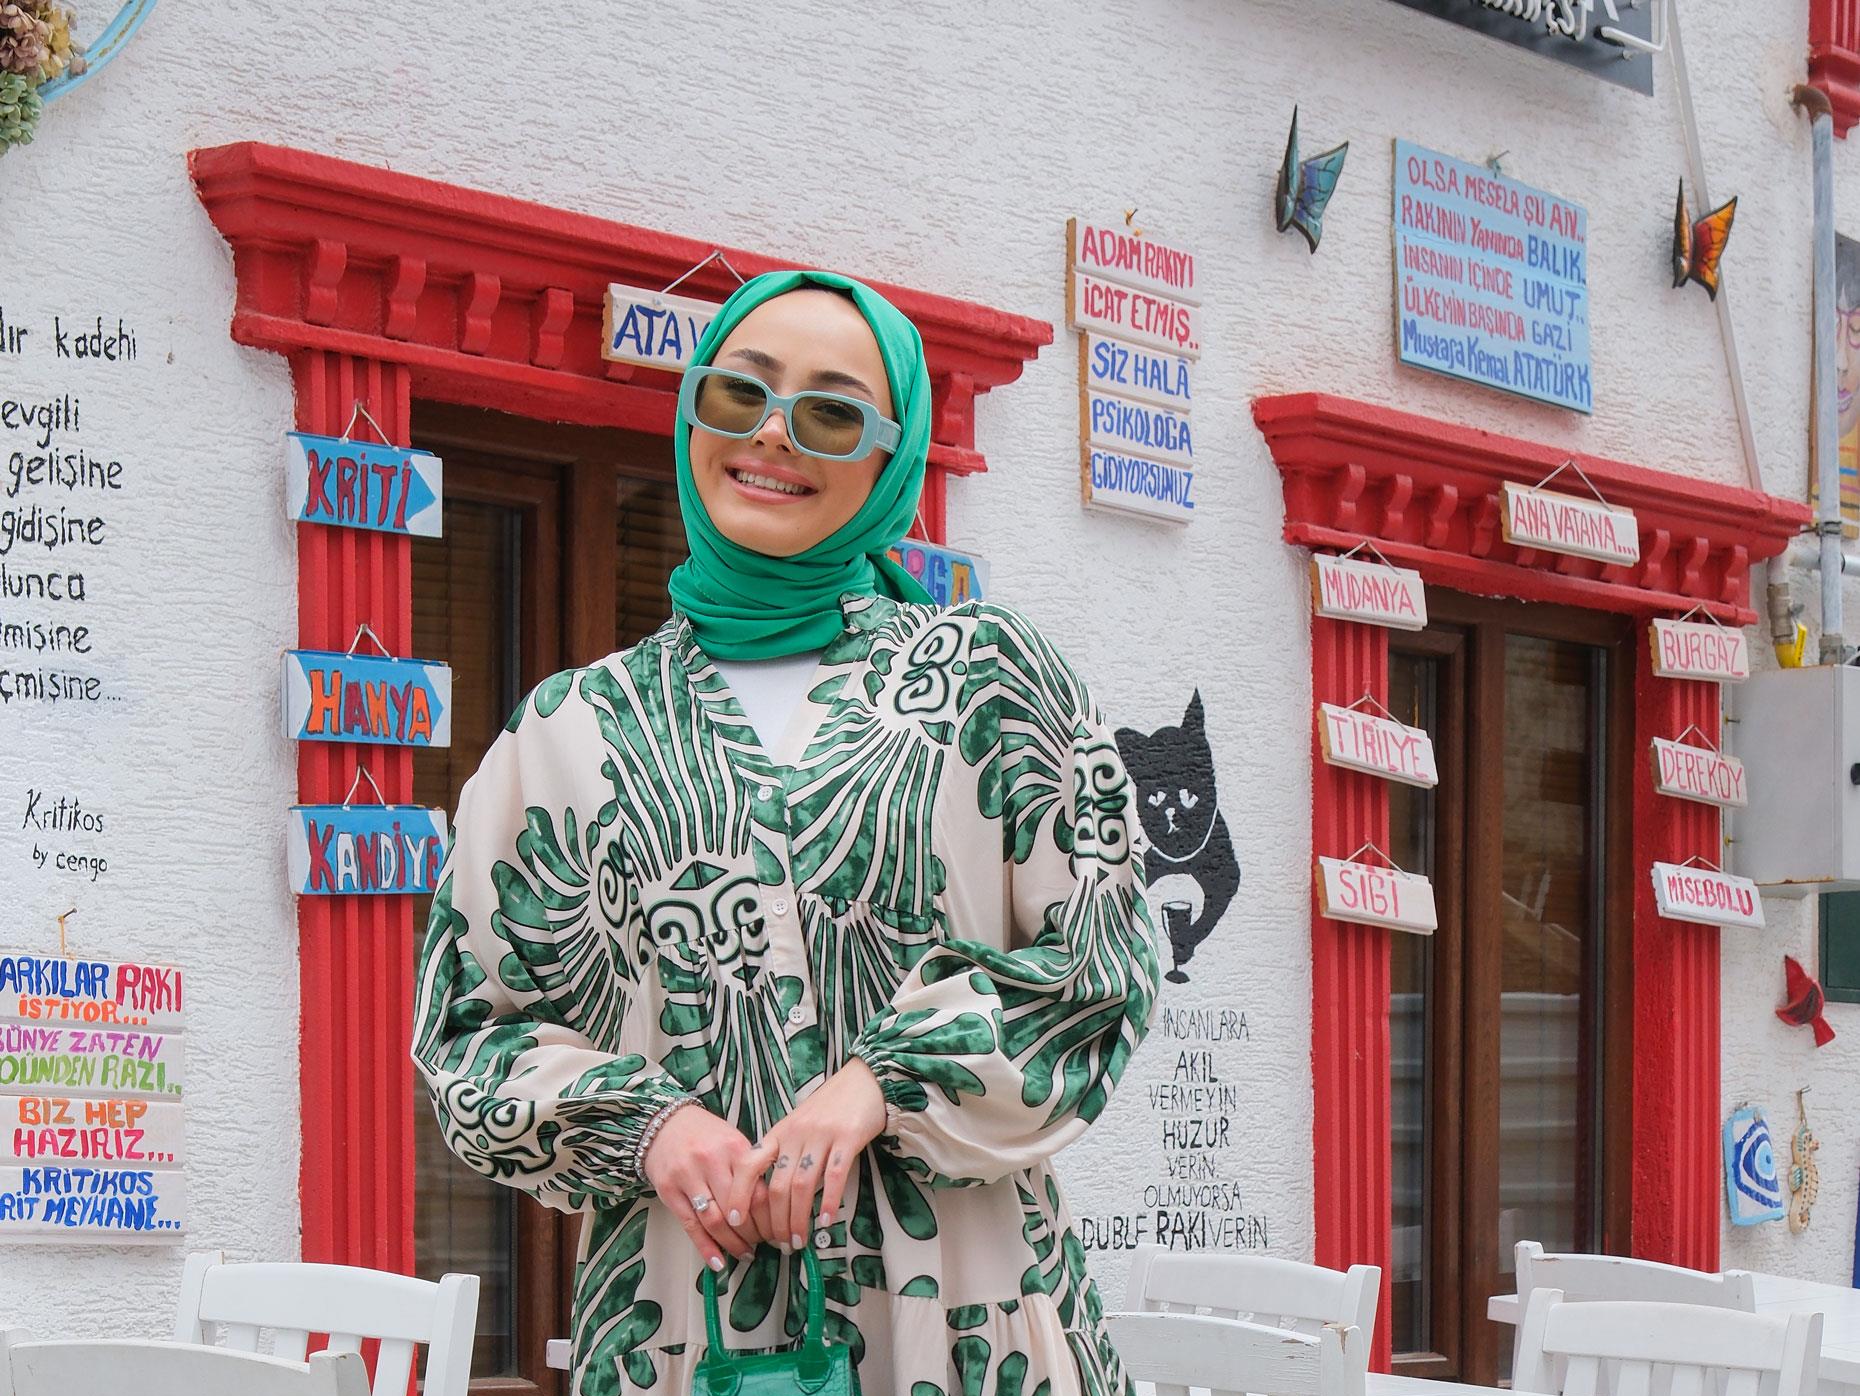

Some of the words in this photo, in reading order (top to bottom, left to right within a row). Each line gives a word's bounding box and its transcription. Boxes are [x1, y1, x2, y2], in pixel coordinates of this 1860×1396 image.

[1407, 156, 1461, 197] OLSA
[1464, 175, 1520, 218] MESELA
[1523, 194, 1546, 228] ŞU
[1401, 194, 1467, 245] RAKININ
[1081, 226, 1141, 272] ADAM
[1144, 241, 1193, 288] RAKIYI
[1403, 235, 1463, 284] İNSANIN
[1084, 278, 1128, 324] İCAT
[1131, 294, 1199, 349] ETMİŞ..
[1403, 275, 1465, 327] ÜLKEMİN
[1468, 301, 1526, 343] BAŞINDA
[1531, 320, 1573, 352] GAZİ
[54, 316, 137, 361] kadehi
[1091, 341, 1128, 384] SİZ
[1467, 336, 1511, 385] Kemal
[1513, 350, 1592, 407] ATATÜRK
[1, 393, 80, 449] evgili
[1091, 398, 1192, 456] PSİKOLOĞA
[6, 448, 123, 498] gelişine
[305, 449, 412, 530] KRİTİ
[1091, 452, 1194, 508] GİDİYORSUNUZ
[0, 504, 105, 555] gidişine
[1513, 494, 1552, 542] ANA
[0, 563, 85, 600] lunca
[1324, 566, 1417, 617] MUDANYA
[0, 621, 92, 654] mişine
[1663, 628, 1744, 676] BURGAZ
[306, 669, 432, 743] HANYA
[23, 789, 103, 832] Kritikos
[32, 843, 48, 869] by
[56, 852, 107, 882] cengo
[309, 818, 440, 893] KANDİYE
[0, 957, 109, 1000] ARKILAR
[116, 964, 182, 1015] RAKI
[19, 994, 148, 1026] İSTİYOR...
[69, 1031, 163, 1062] ZATEN
[1173, 1050, 1218, 1082] AKIL
[101, 1055, 182, 1095] RAZI..
[1149, 1083, 1236, 1113] VERMEYİN
[85, 1099, 148, 1128] HEP
[1163, 1116, 1230, 1150] HUZUR
[14, 1128, 174, 1162] HAZIRIZ...
[23, 1166, 153, 1196] KRİTİKOS
[1144, 1181, 1242, 1212] OLMUYORSA
[42, 1194, 181, 1231] MEYHANE...
[1156, 1210, 1206, 1251] RAKI
[1208, 1214, 1268, 1249] VERİN
